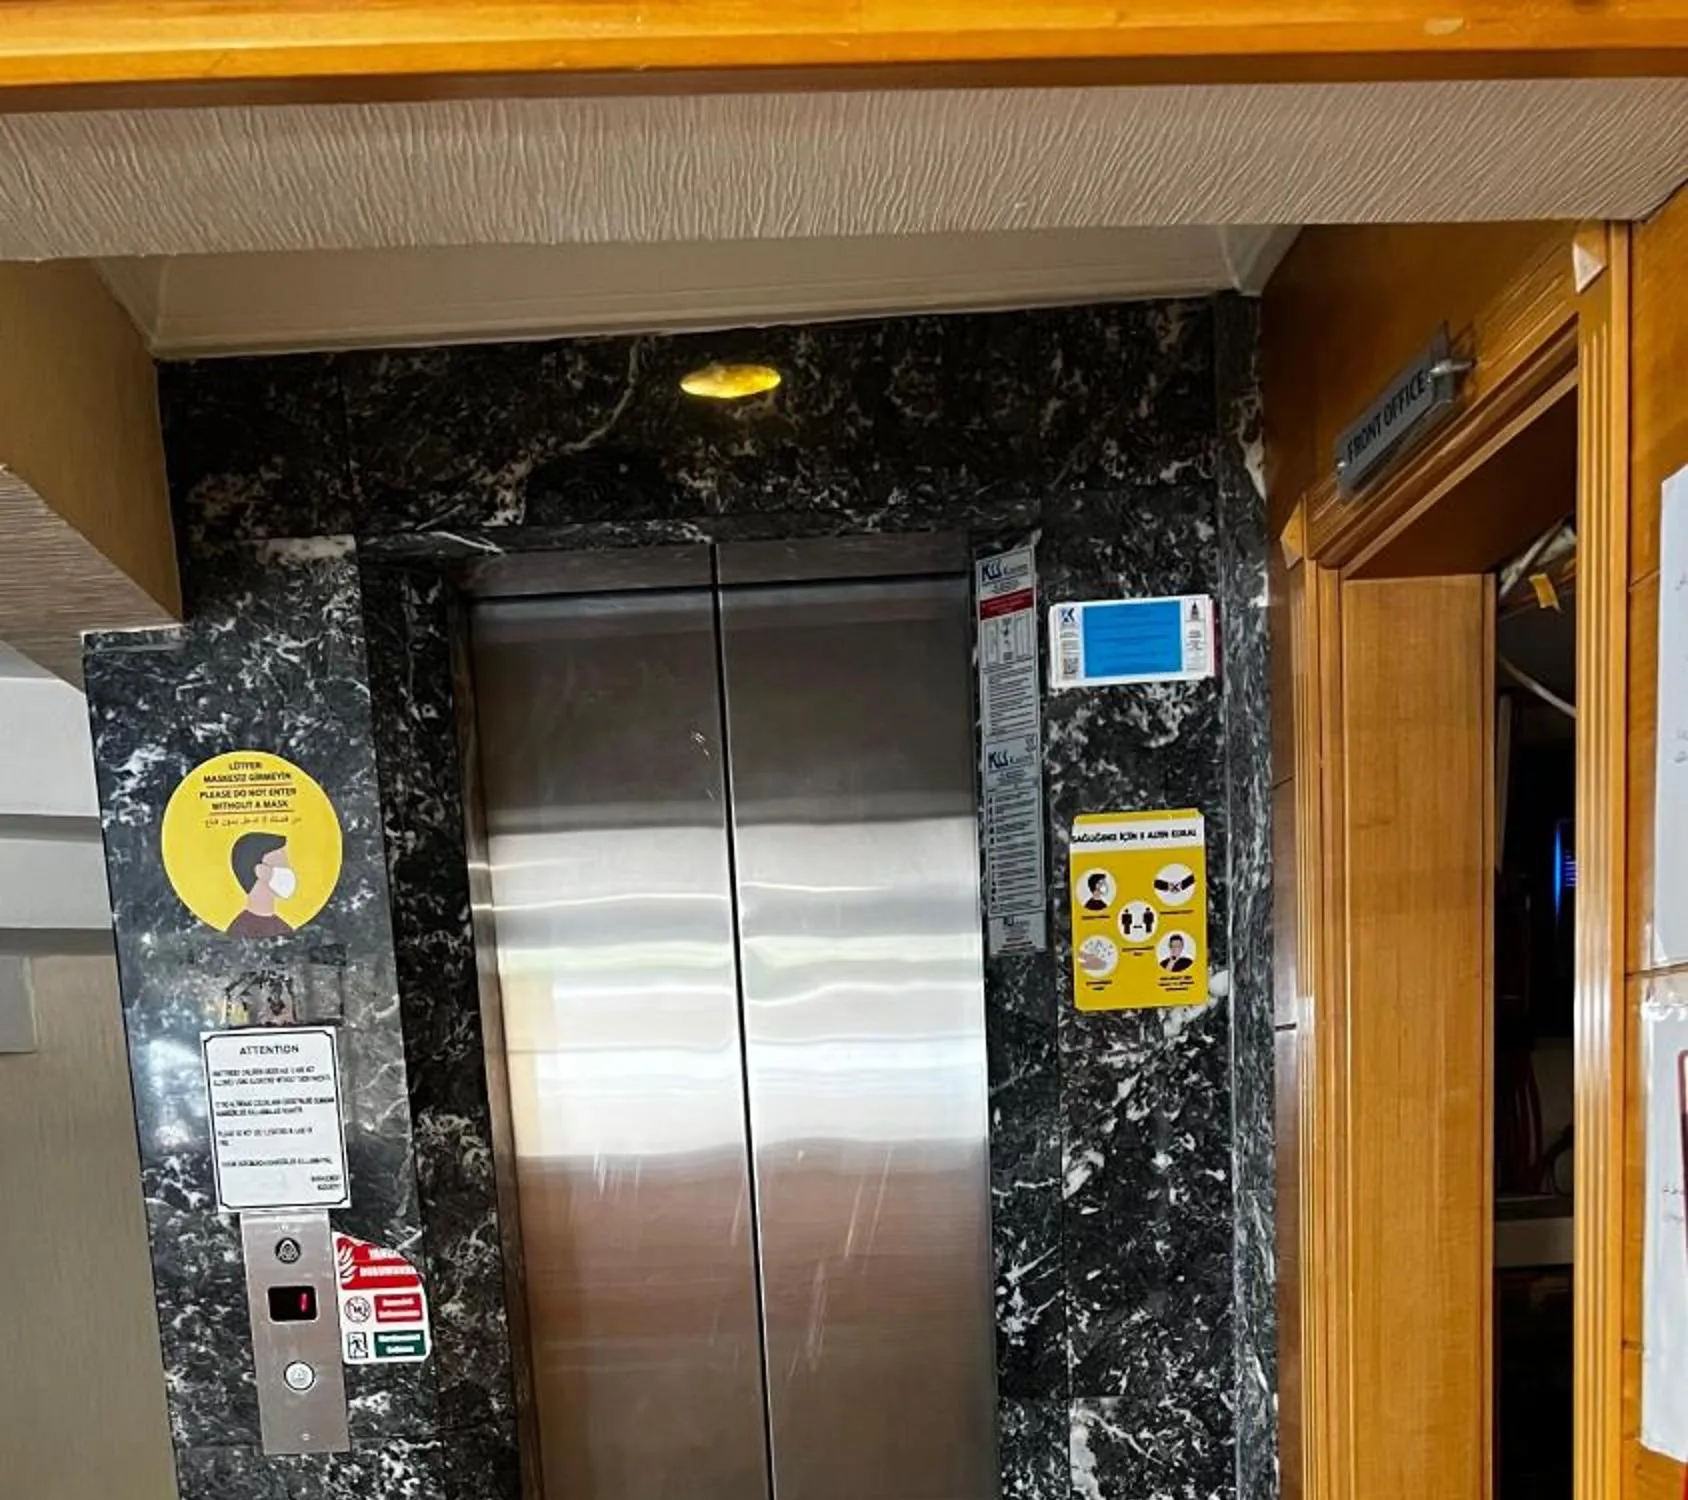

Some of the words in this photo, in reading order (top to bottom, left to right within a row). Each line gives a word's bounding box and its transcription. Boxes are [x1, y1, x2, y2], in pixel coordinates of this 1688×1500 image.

[1346, 412, 1382, 465] FRONT
[1384, 368, 1425, 427] OFFICE
[200, 790, 231, 799] PLEASE
[234, 789, 247, 797] DO
[249, 788, 266, 797] NOT
[269, 787, 297, 796] ENTER
[211, 801, 252, 810] WITHOUT
[264, 799, 289, 808] MASK
[240, 1044, 300, 1056] ATTENTION
